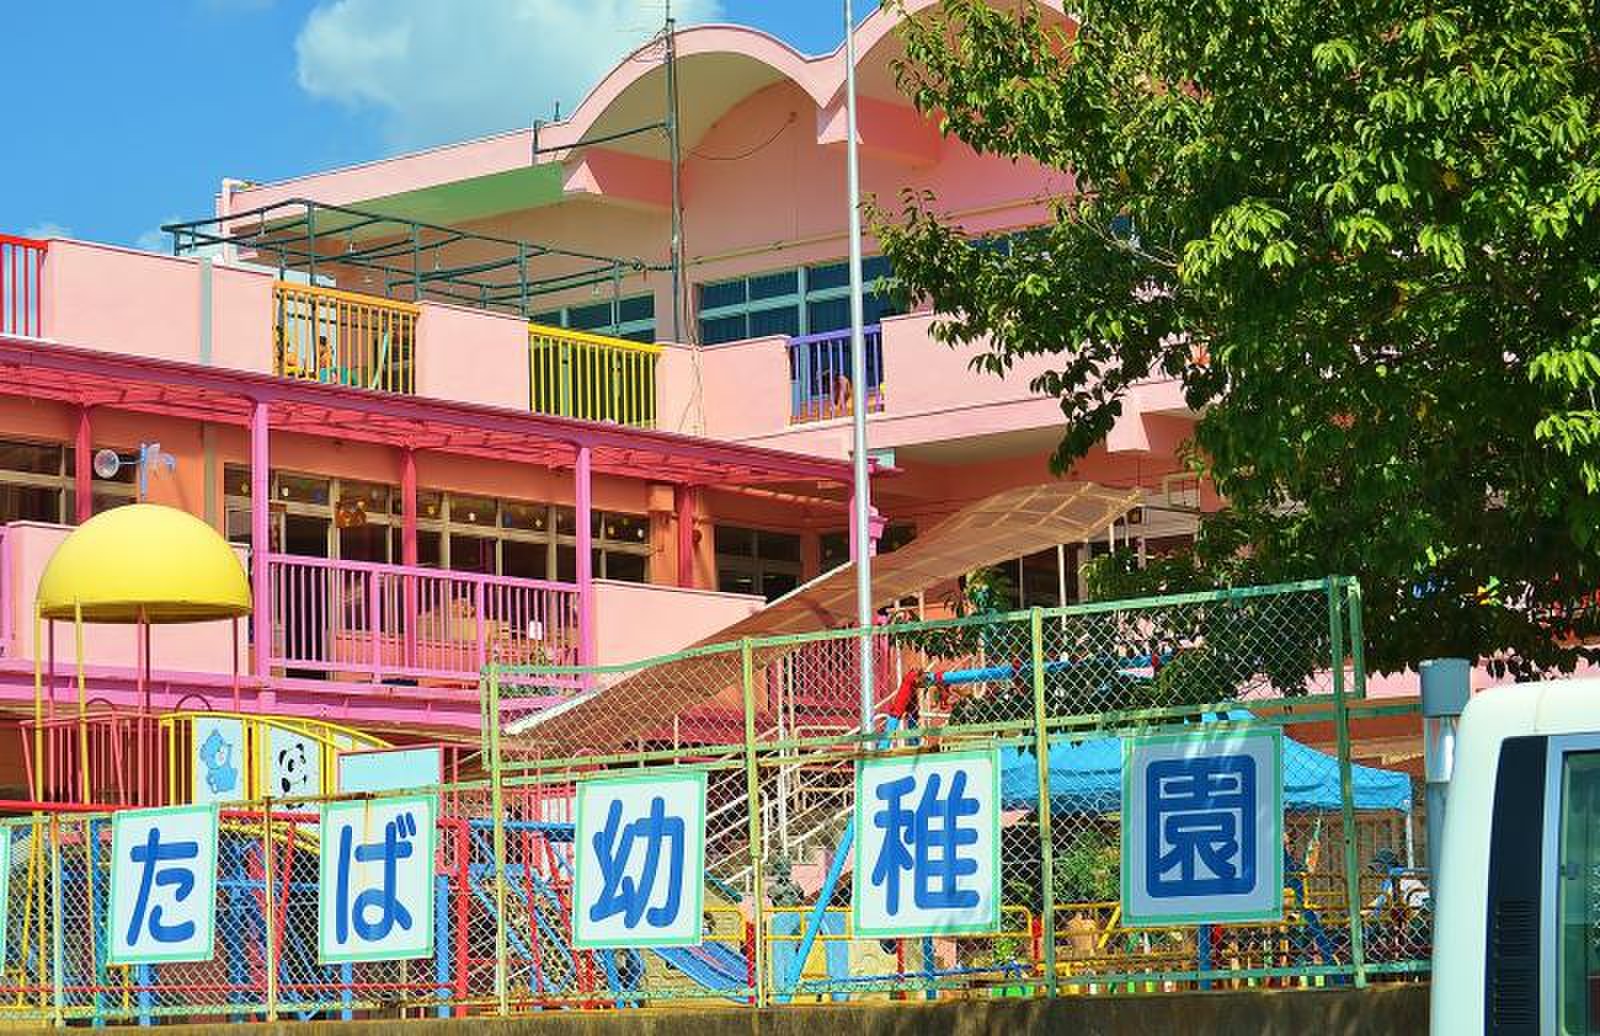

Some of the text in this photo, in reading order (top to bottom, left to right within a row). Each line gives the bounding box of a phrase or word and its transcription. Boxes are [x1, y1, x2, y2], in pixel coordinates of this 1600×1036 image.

[126, 754, 1257, 947] た ば 幼 稚 園
